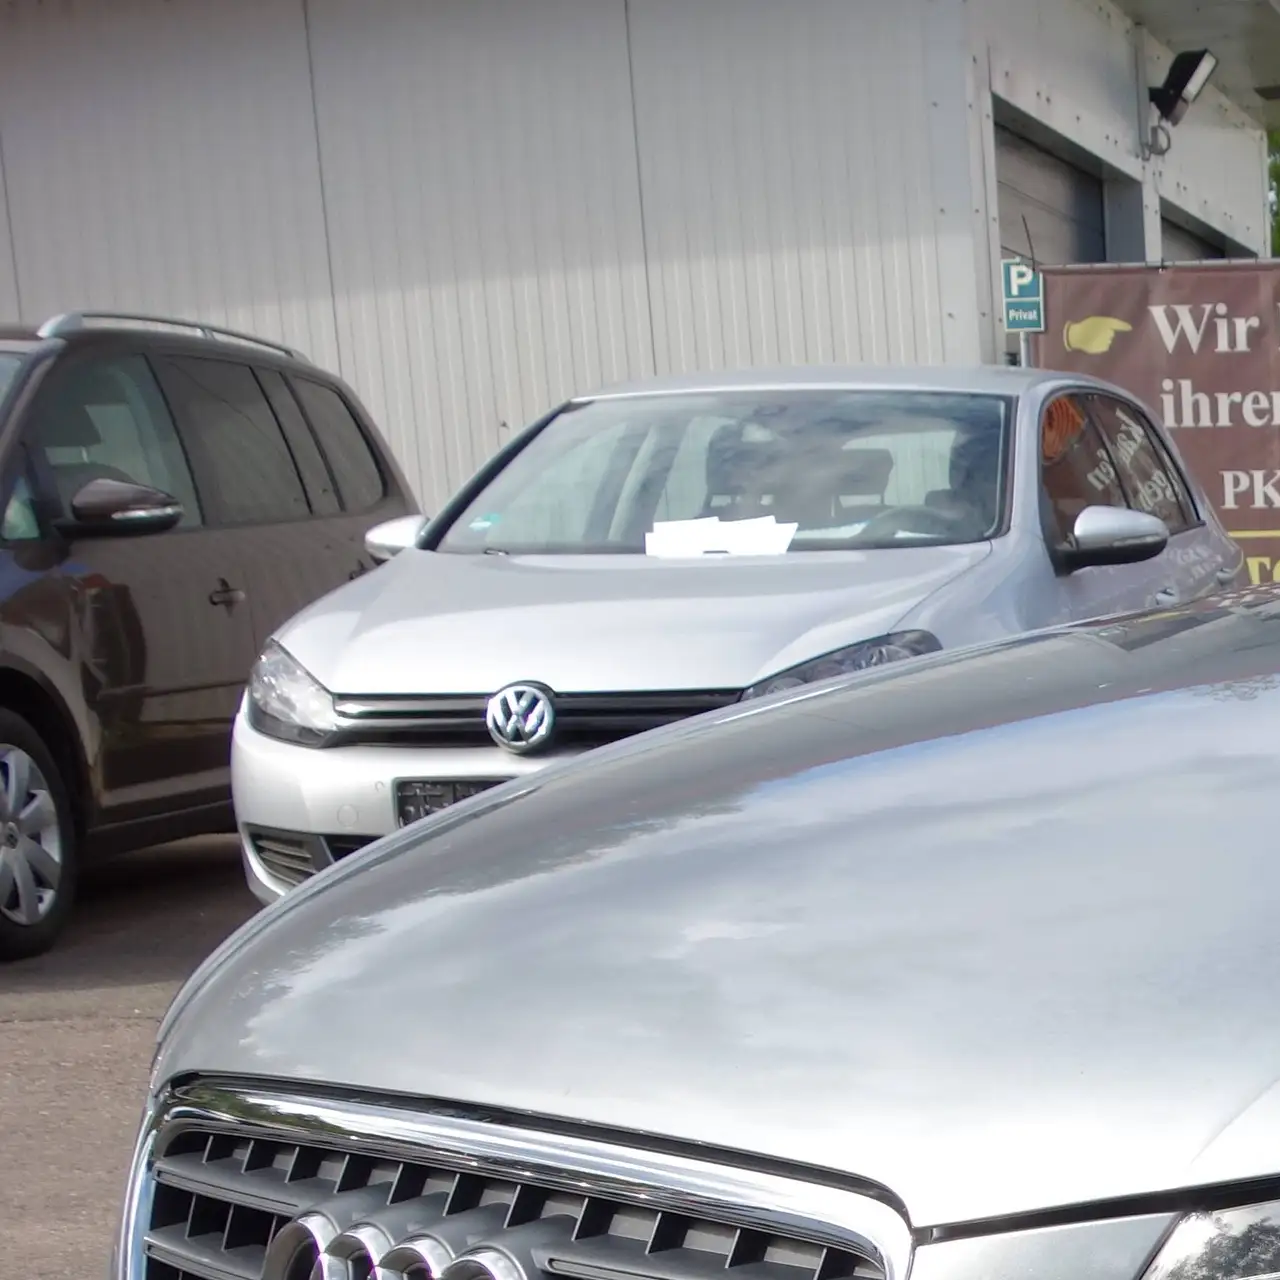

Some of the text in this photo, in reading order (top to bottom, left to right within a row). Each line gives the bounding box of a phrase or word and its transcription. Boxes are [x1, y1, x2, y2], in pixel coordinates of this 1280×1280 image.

[1010, 264, 1033, 296] P
[1008, 306, 1039, 321] Privat
[1148, 302, 1260, 354] Wir
